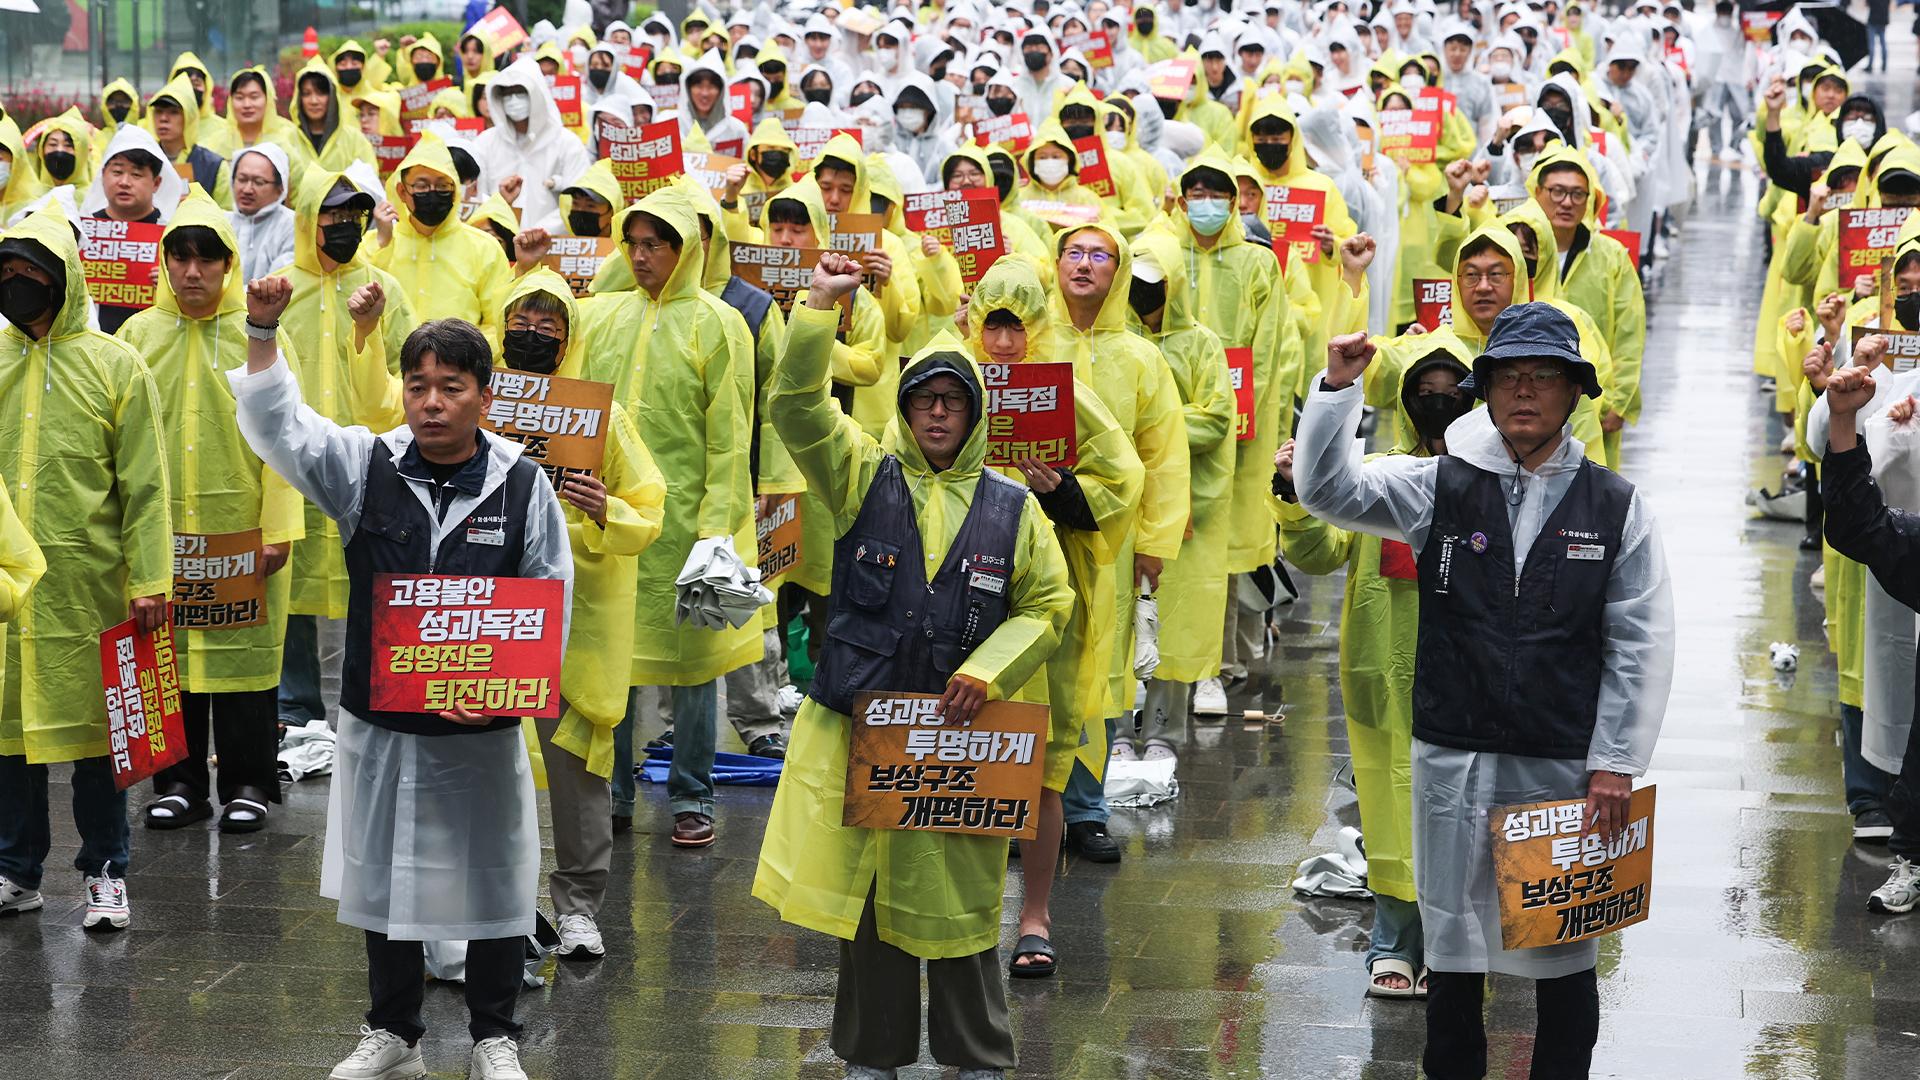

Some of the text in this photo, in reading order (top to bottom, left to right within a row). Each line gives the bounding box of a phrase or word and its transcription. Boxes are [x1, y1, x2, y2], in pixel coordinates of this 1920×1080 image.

[610, 135, 673, 161] 성과독점
[733, 246, 801, 266] 성과평가
[487, 400, 602, 437] 투명하게
[389, 577, 496, 607] 고용불안
[418, 608, 546, 642] 성과독점
[389, 643, 493, 673] 경영진은
[116, 636, 146, 740] 성과독점
[424, 677, 551, 710] 퇴진하라
[140, 667, 166, 757] 경영진은
[865, 698, 970, 727] 성과평
[105, 686, 132, 775] 고용불안
[905, 729, 1036, 764] 투명하게
[867, 765, 980, 793] 보상구조
[898, 796, 1030, 831] 개편하라
[1502, 803, 1599, 842] 성과평
[1551, 816, 1649, 871] 투명하게
[1521, 865, 1615, 910] 보상구조
[1556, 882, 1646, 942] 개편하라
